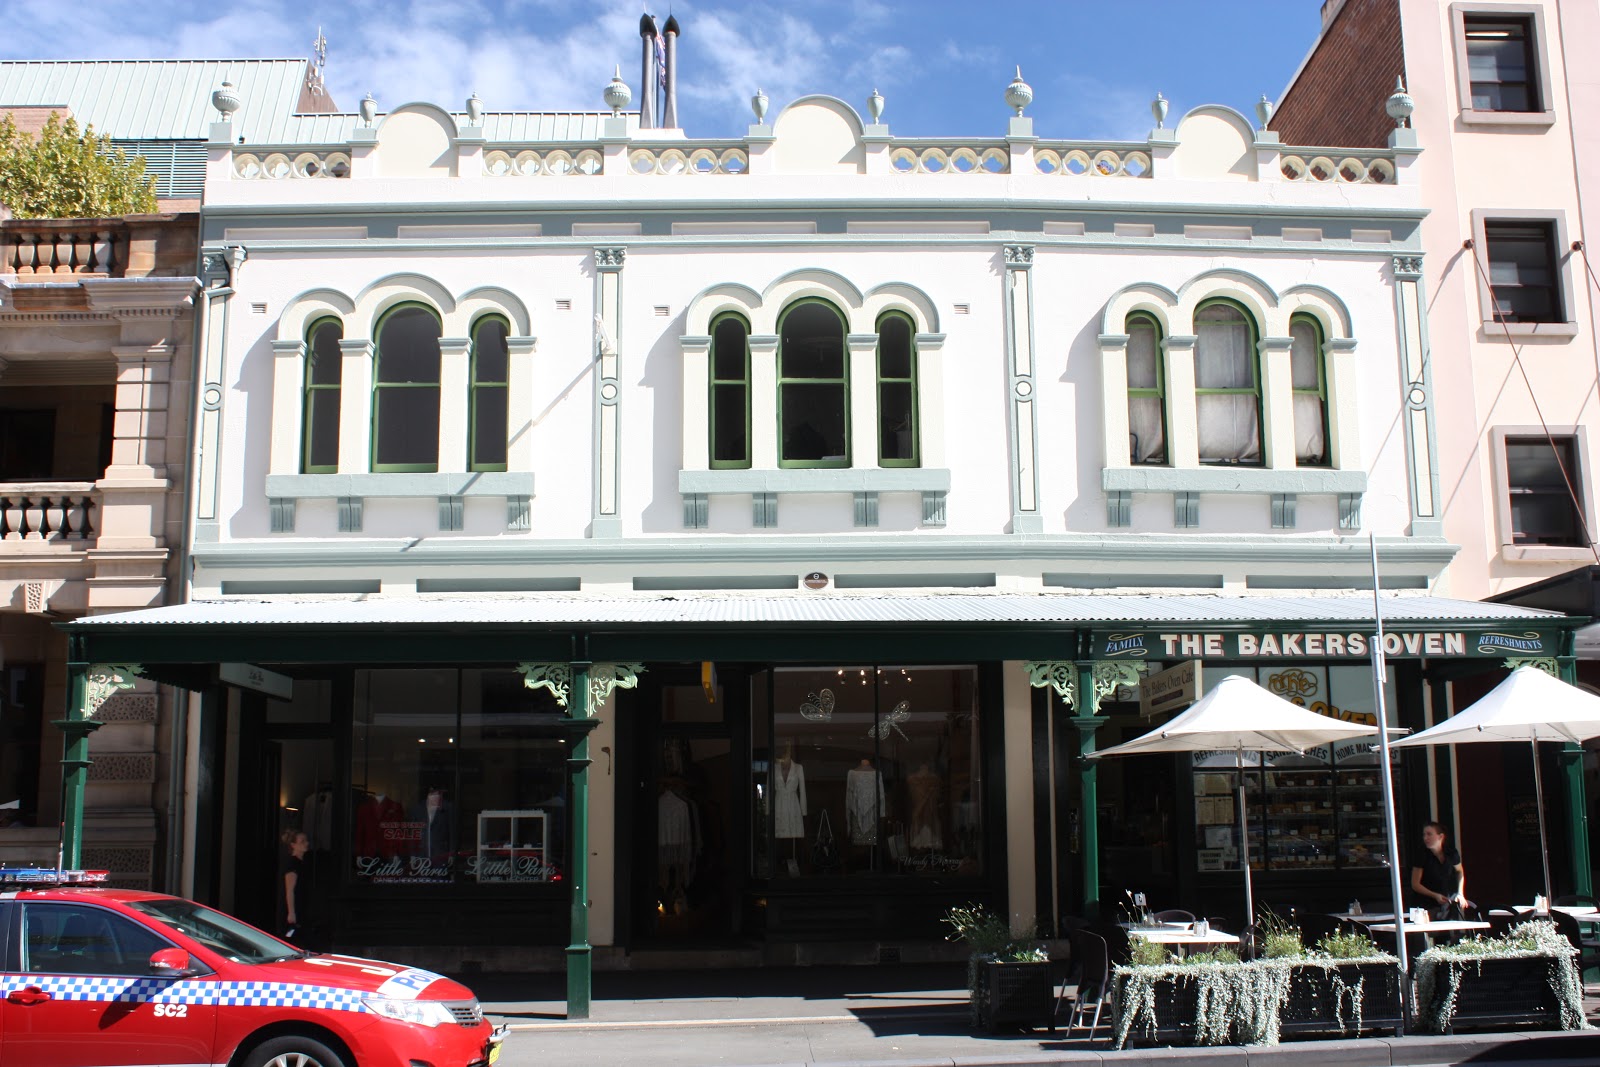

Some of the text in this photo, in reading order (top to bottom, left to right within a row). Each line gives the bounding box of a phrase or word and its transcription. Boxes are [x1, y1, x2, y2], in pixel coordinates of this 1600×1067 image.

[1105, 635, 1144, 653] FAMILY
[1160, 633, 1465, 656] THE BAKERS OVEN
[1479, 635, 1542, 650] REFRESHMENTS
[1151, 680, 1167, 695] Bakers
[1168, 675, 1180, 690] Oven
[1193, 750, 1257, 762] REFRESHMNTS
[1335, 744, 1355, 760] HOME
[384, 828, 422, 840] SALE
[357, 857, 449, 876] Little Paris
[464, 856, 557, 876] Little Paris
[153, 1003, 187, 1018] SC2
